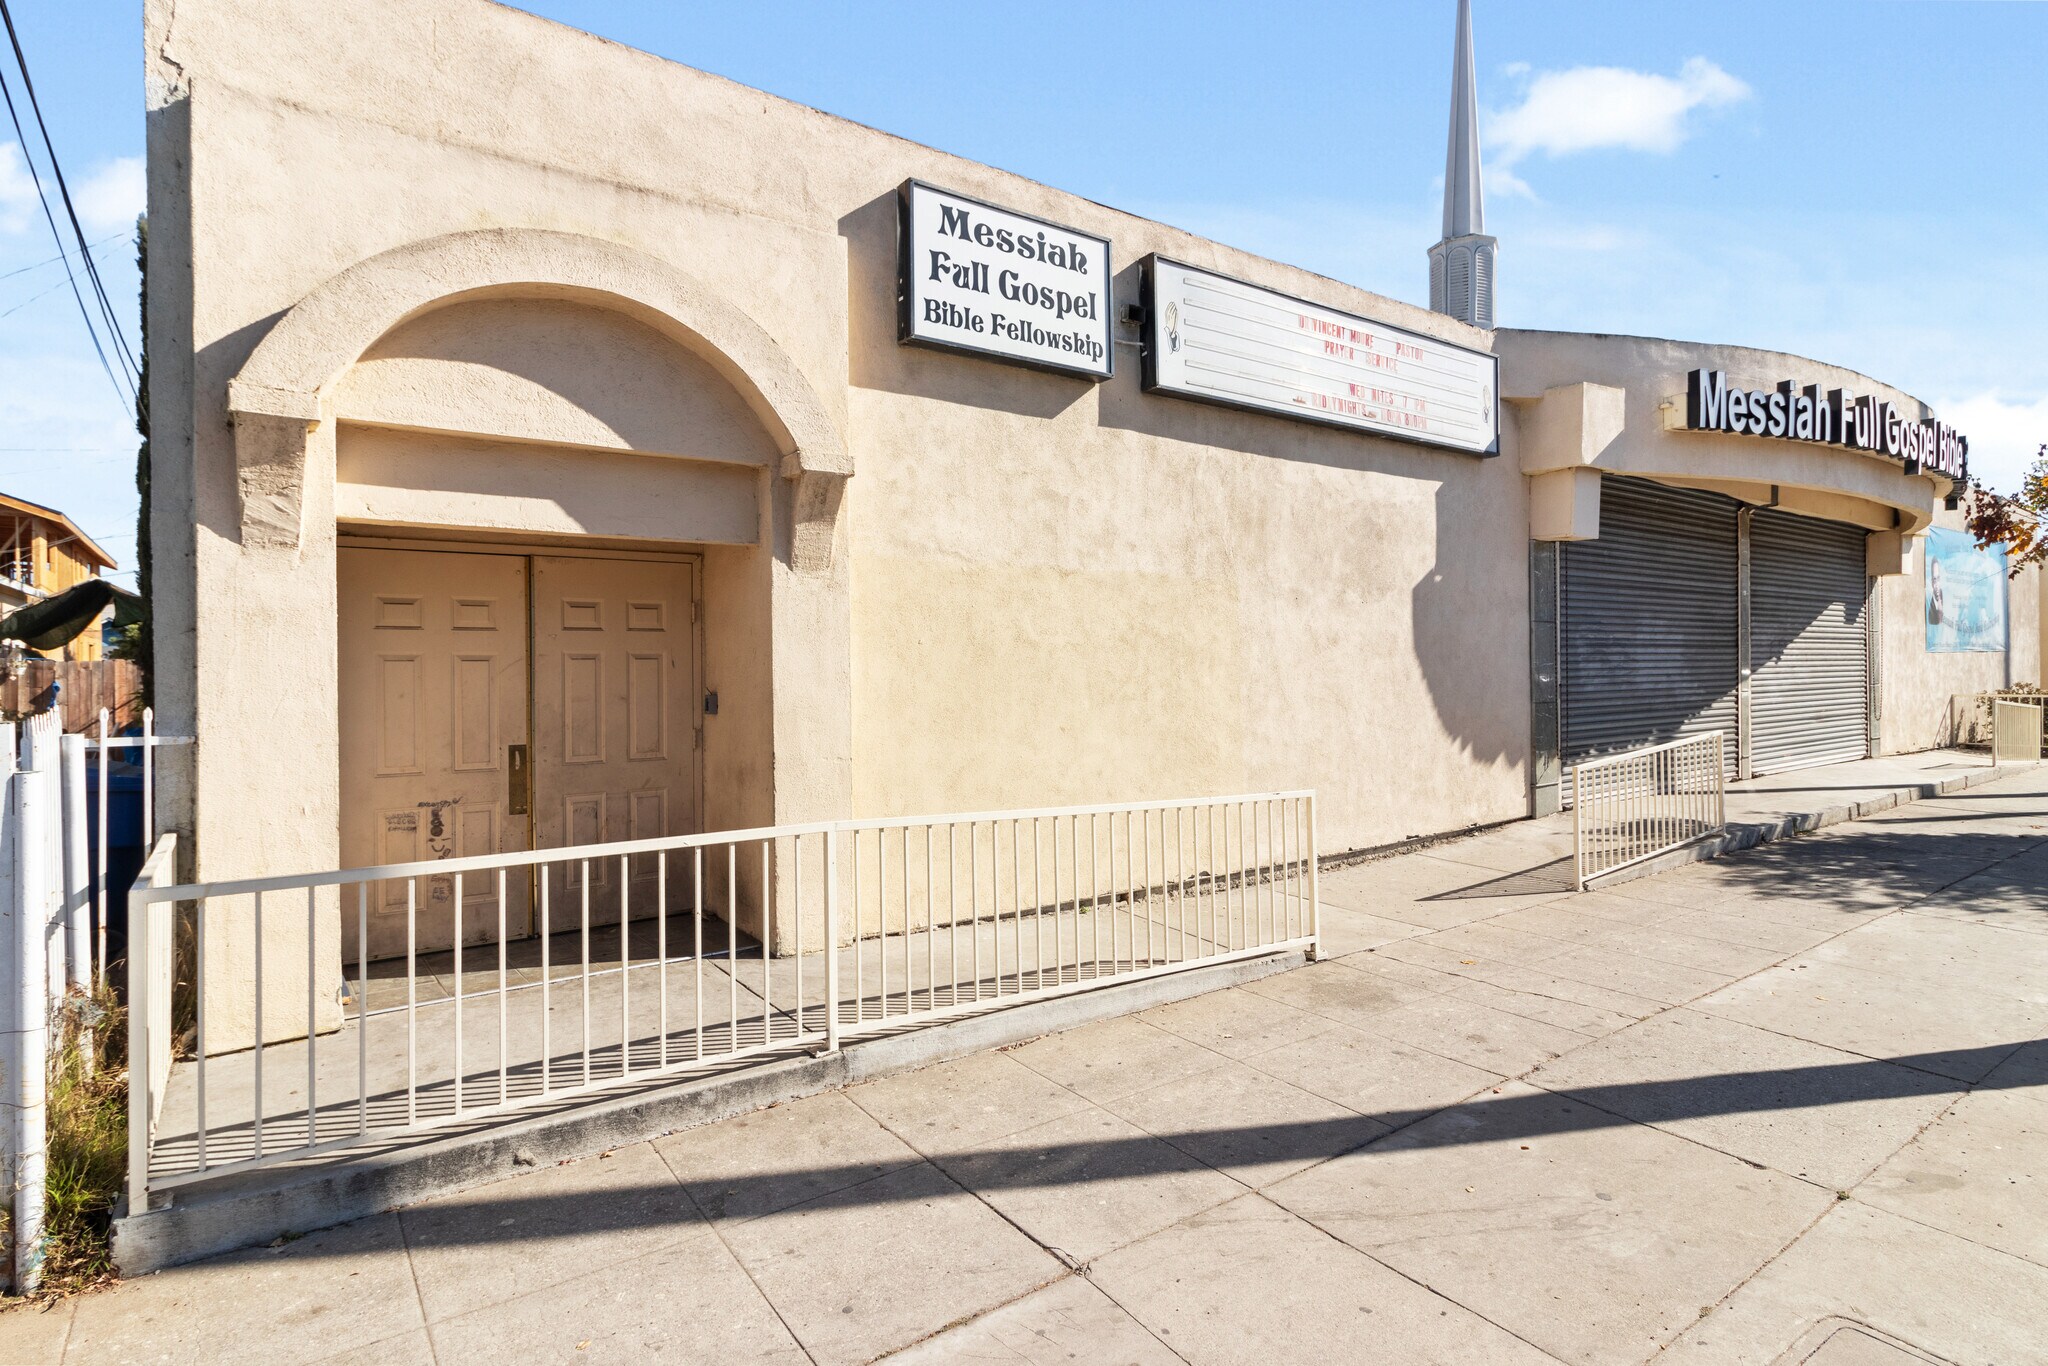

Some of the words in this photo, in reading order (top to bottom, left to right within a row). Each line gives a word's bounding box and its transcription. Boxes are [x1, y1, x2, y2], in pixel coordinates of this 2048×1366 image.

[937, 203, 1088, 275] Messiah
[928, 249, 990, 295] Full
[998, 269, 1098, 321] Gospel
[923, 297, 984, 333] Bible
[990, 313, 1104, 363] Fellowship
[1312, 317, 1345, 340] VINCENT
[1350, 329, 1374, 348] MOORE
[1396, 341, 1424, 361] PASTOR
[1324, 340, 1354, 361] PRAYER
[1366, 351, 1398, 373] SERVICE
[1371, 388, 1394, 405] NITES
[1694, 367, 1831, 442] Messiah
[1840, 388, 1880, 450] Full
[1885, 400, 1937, 475] Gospel
[1938, 421, 1963, 479] Bible
